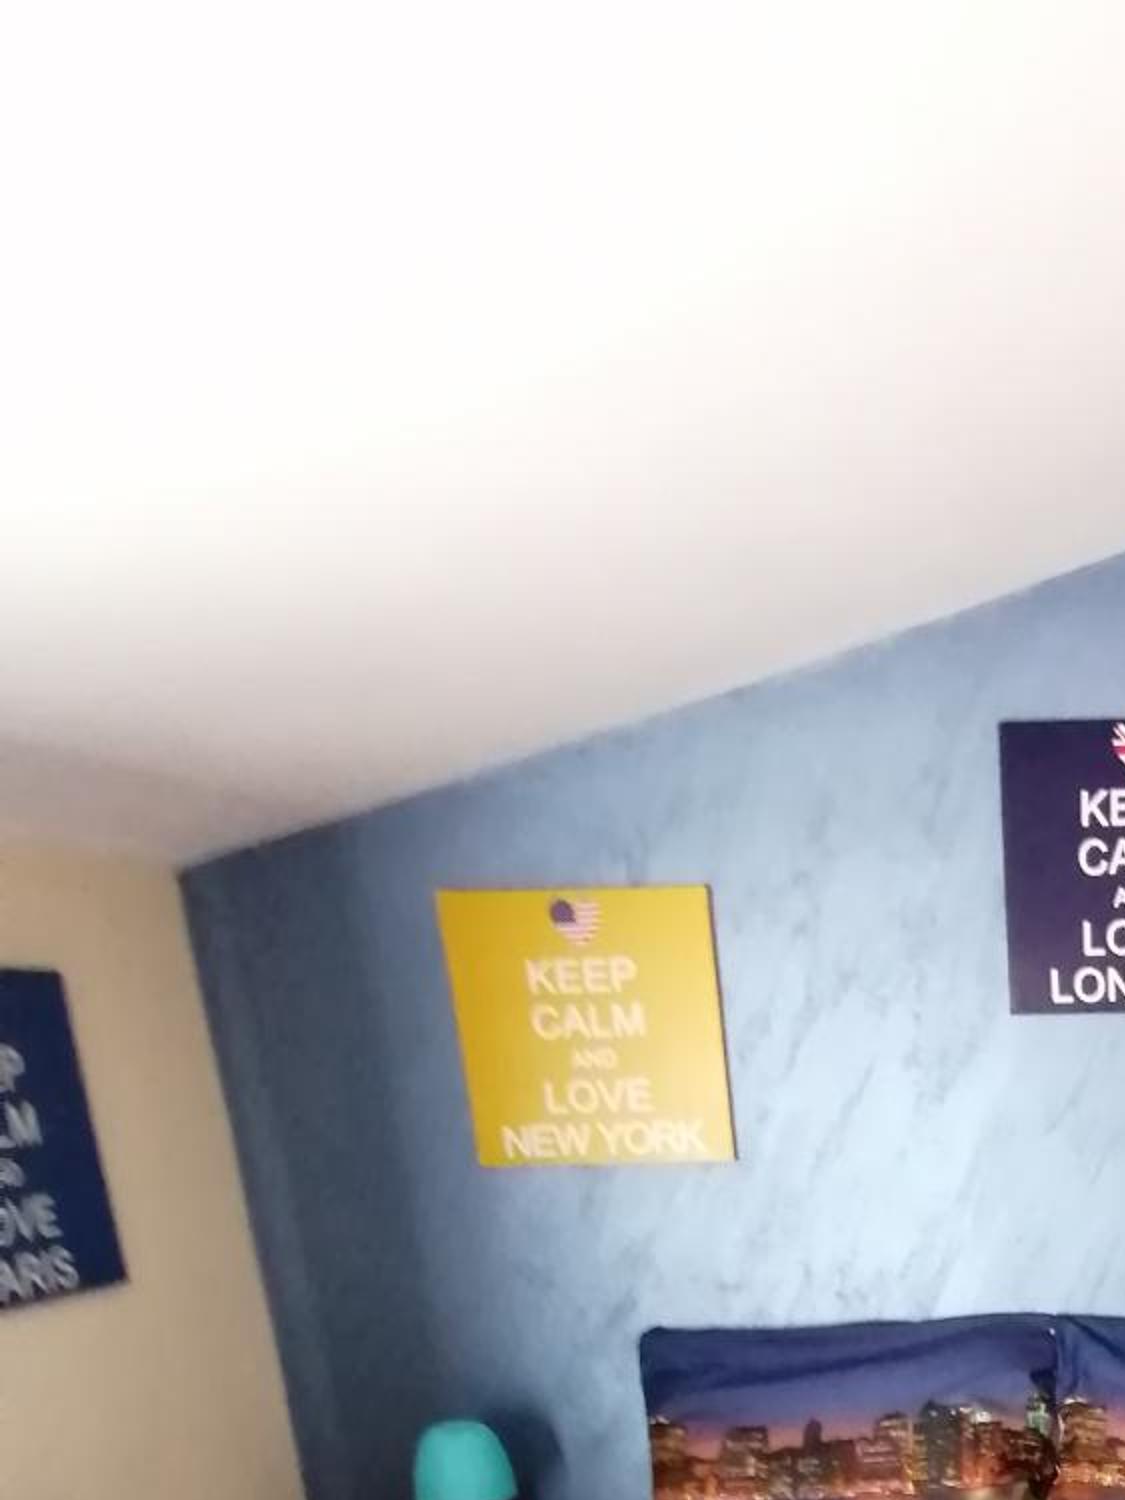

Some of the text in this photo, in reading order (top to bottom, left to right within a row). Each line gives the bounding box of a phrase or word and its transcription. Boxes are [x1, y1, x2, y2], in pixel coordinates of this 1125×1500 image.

[526, 956, 637, 994] KEEP
[532, 1001, 646, 1040] CALM
[573, 1047, 617, 1070] AND
[544, 1077, 654, 1115] LOVE
[502, 1118, 708, 1159] NEW YORK
